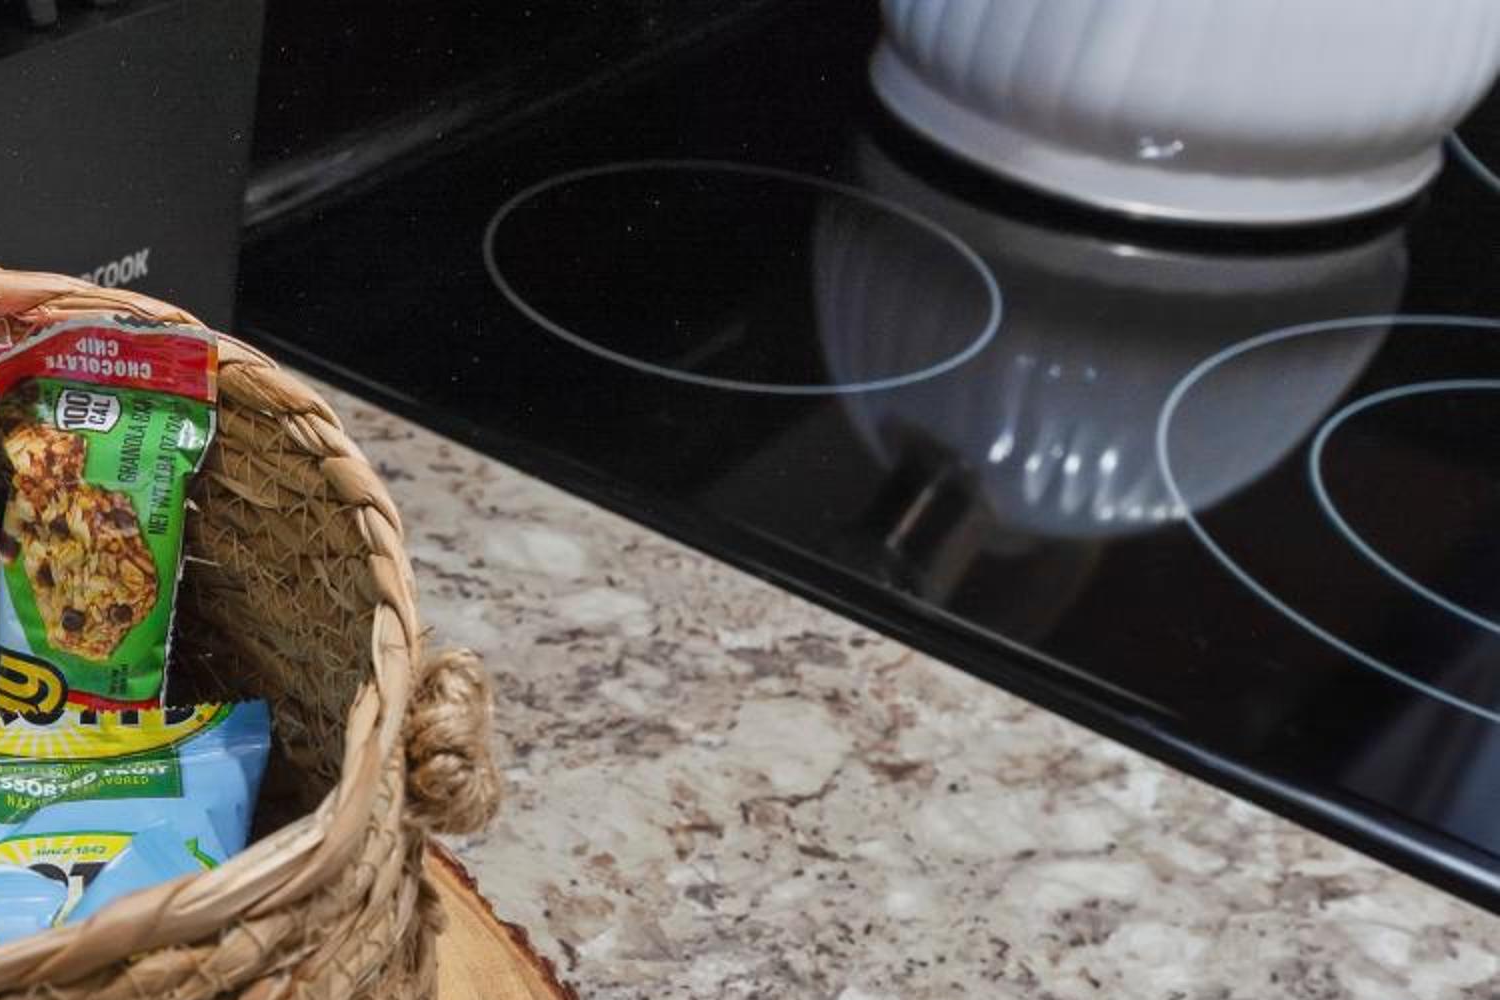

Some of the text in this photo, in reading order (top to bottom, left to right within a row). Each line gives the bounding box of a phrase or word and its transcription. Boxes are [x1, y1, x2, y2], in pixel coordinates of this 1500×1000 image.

[76, 336, 120, 358] CHIP
[44, 353, 153, 379] CHOCOLATE
[63, 390, 93, 426] 100
[88, 399, 112, 425] CAL
[117, 424, 148, 483] GRANOLA
[148, 512, 171, 535] NET
